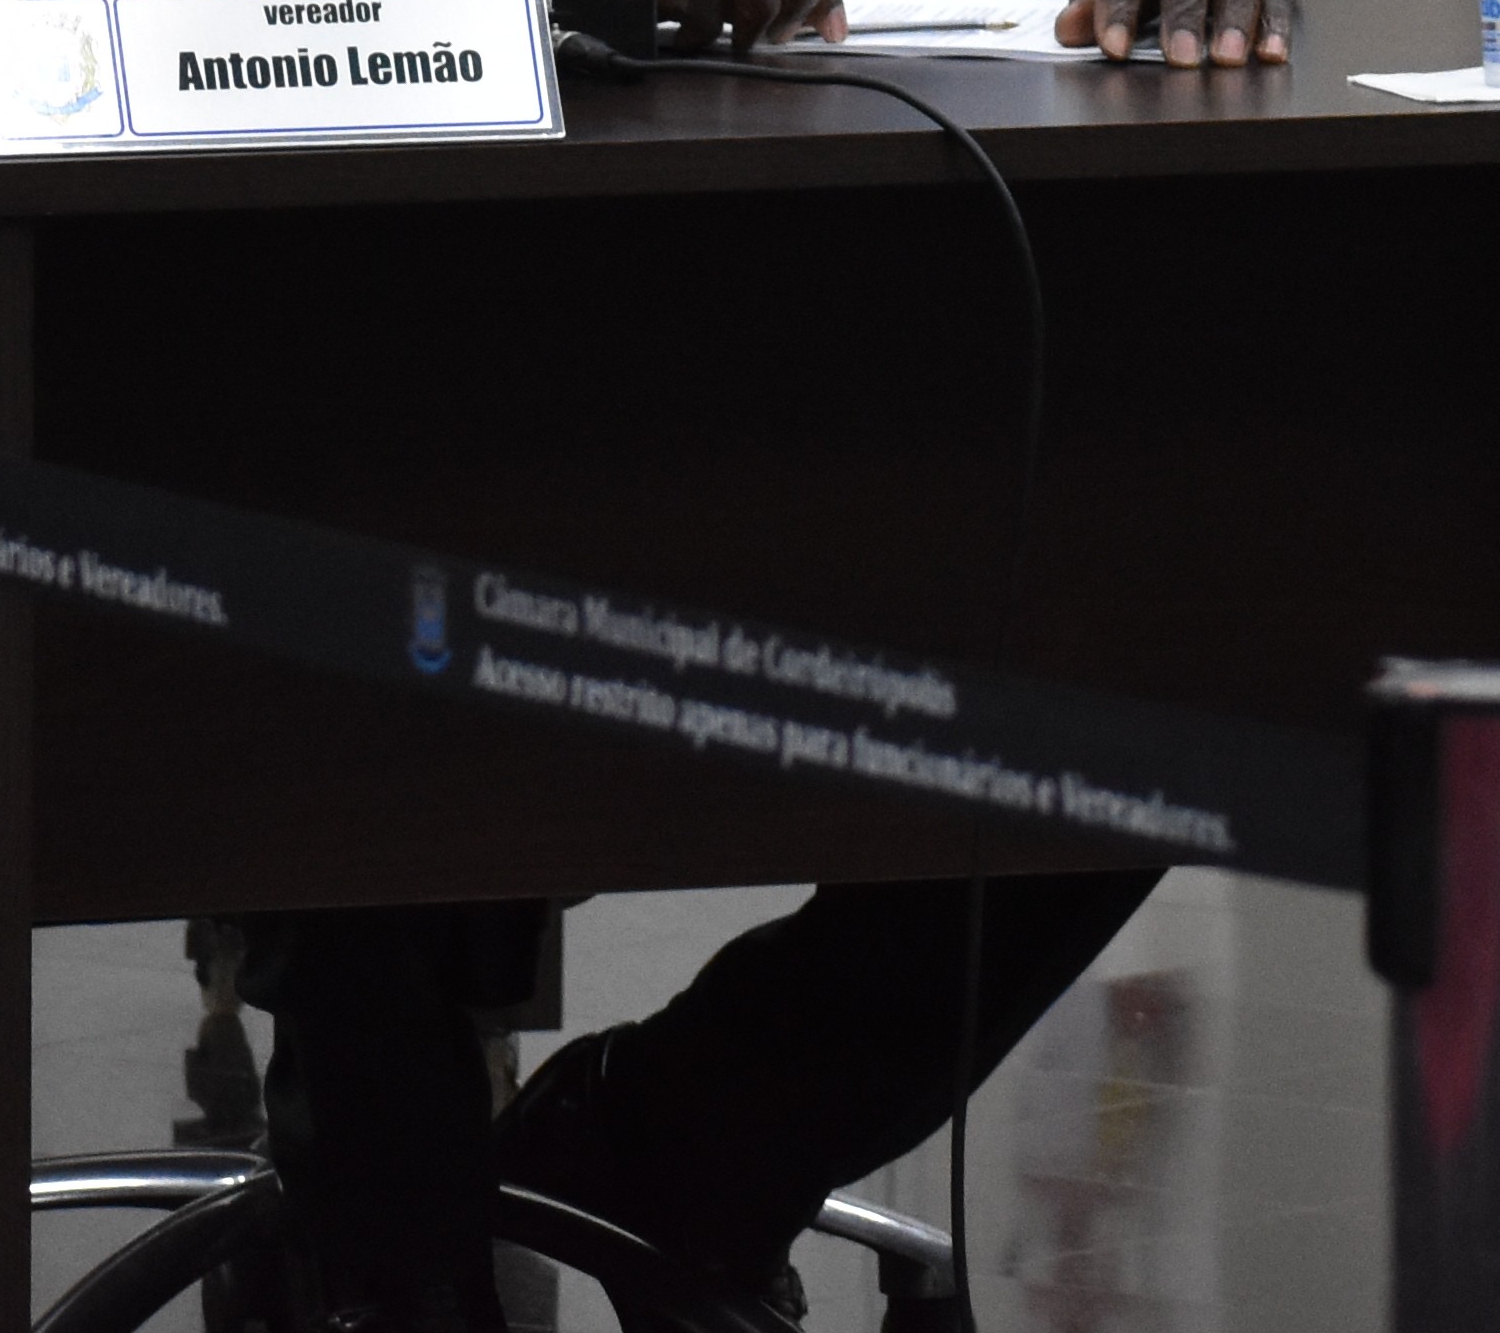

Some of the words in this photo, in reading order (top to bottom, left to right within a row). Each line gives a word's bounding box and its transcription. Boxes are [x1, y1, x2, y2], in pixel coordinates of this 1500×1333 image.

[178, 45, 338, 92] Antonio
[347, 41, 484, 87] Lemão
[58, 554, 73, 589] e
[474, 571, 578, 636] Câmara
[584, 596, 719, 674] Municipal
[723, 625, 759, 676] de
[473, 644, 567, 706] Acesso
[678, 698, 778, 751] apenas
[781, 719, 848, 770] para
[1035, 776, 1054, 815] e
